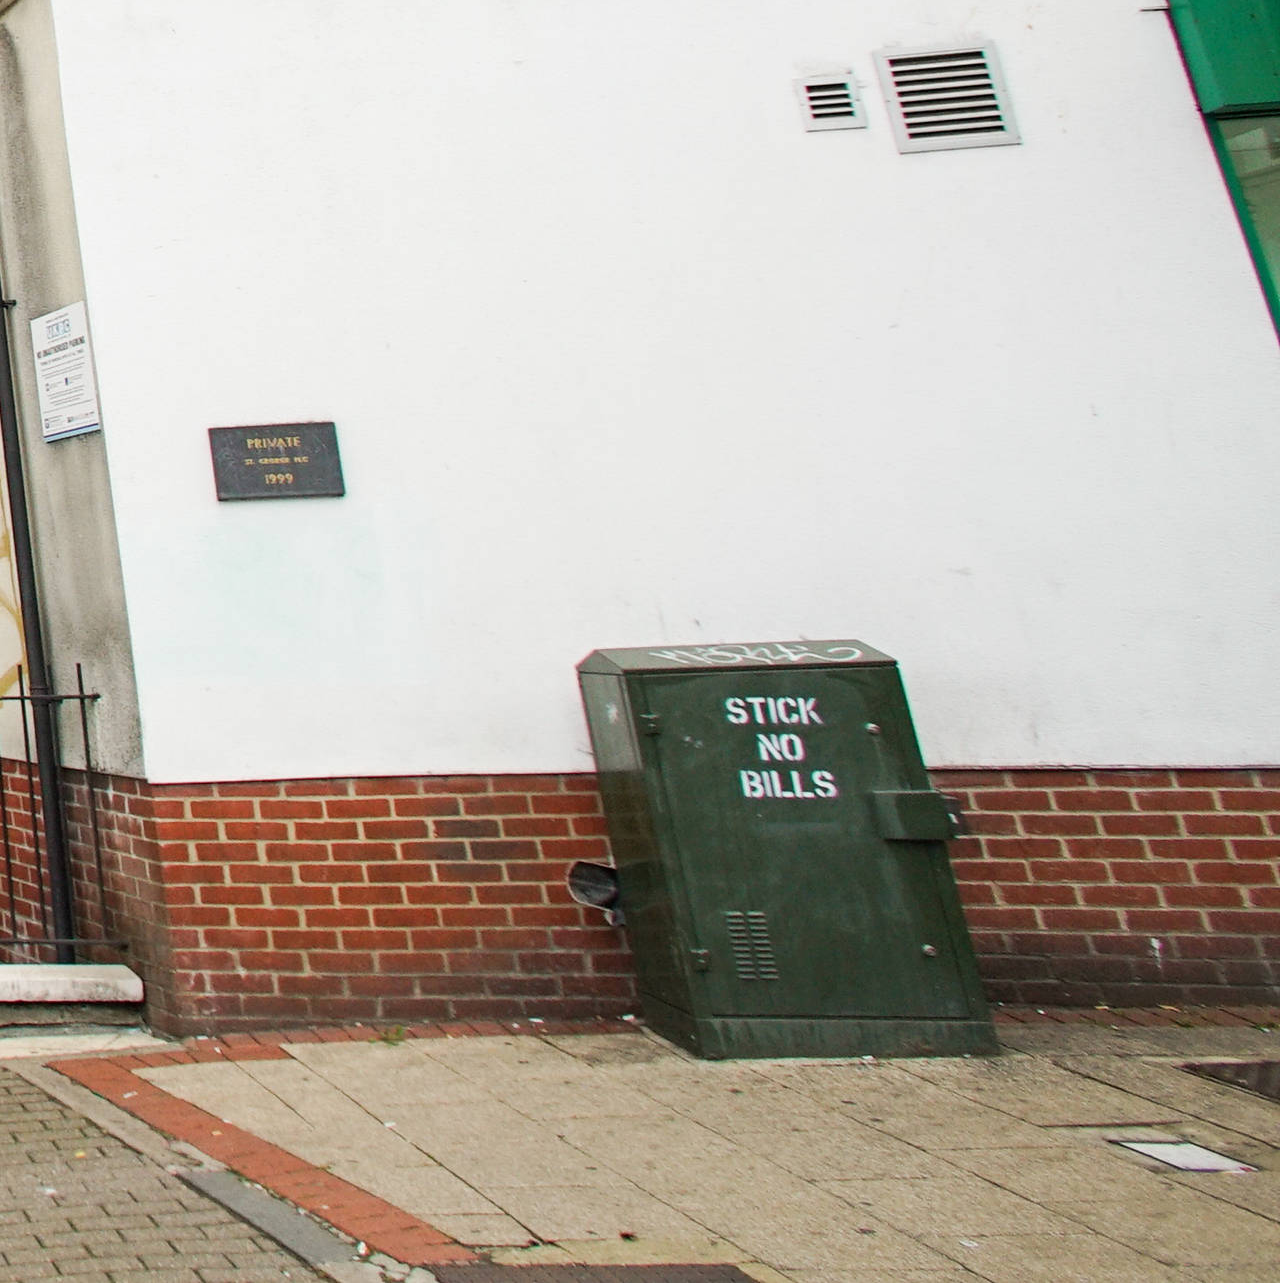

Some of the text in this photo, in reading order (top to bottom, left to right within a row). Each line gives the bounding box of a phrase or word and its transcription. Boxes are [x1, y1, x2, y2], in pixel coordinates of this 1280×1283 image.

[246, 436, 301, 449] PRIVATE
[264, 473, 294, 484] 1999
[725, 696, 824, 725] STICK
[756, 733, 806, 761] NO
[739, 769, 839, 798] BILLS
